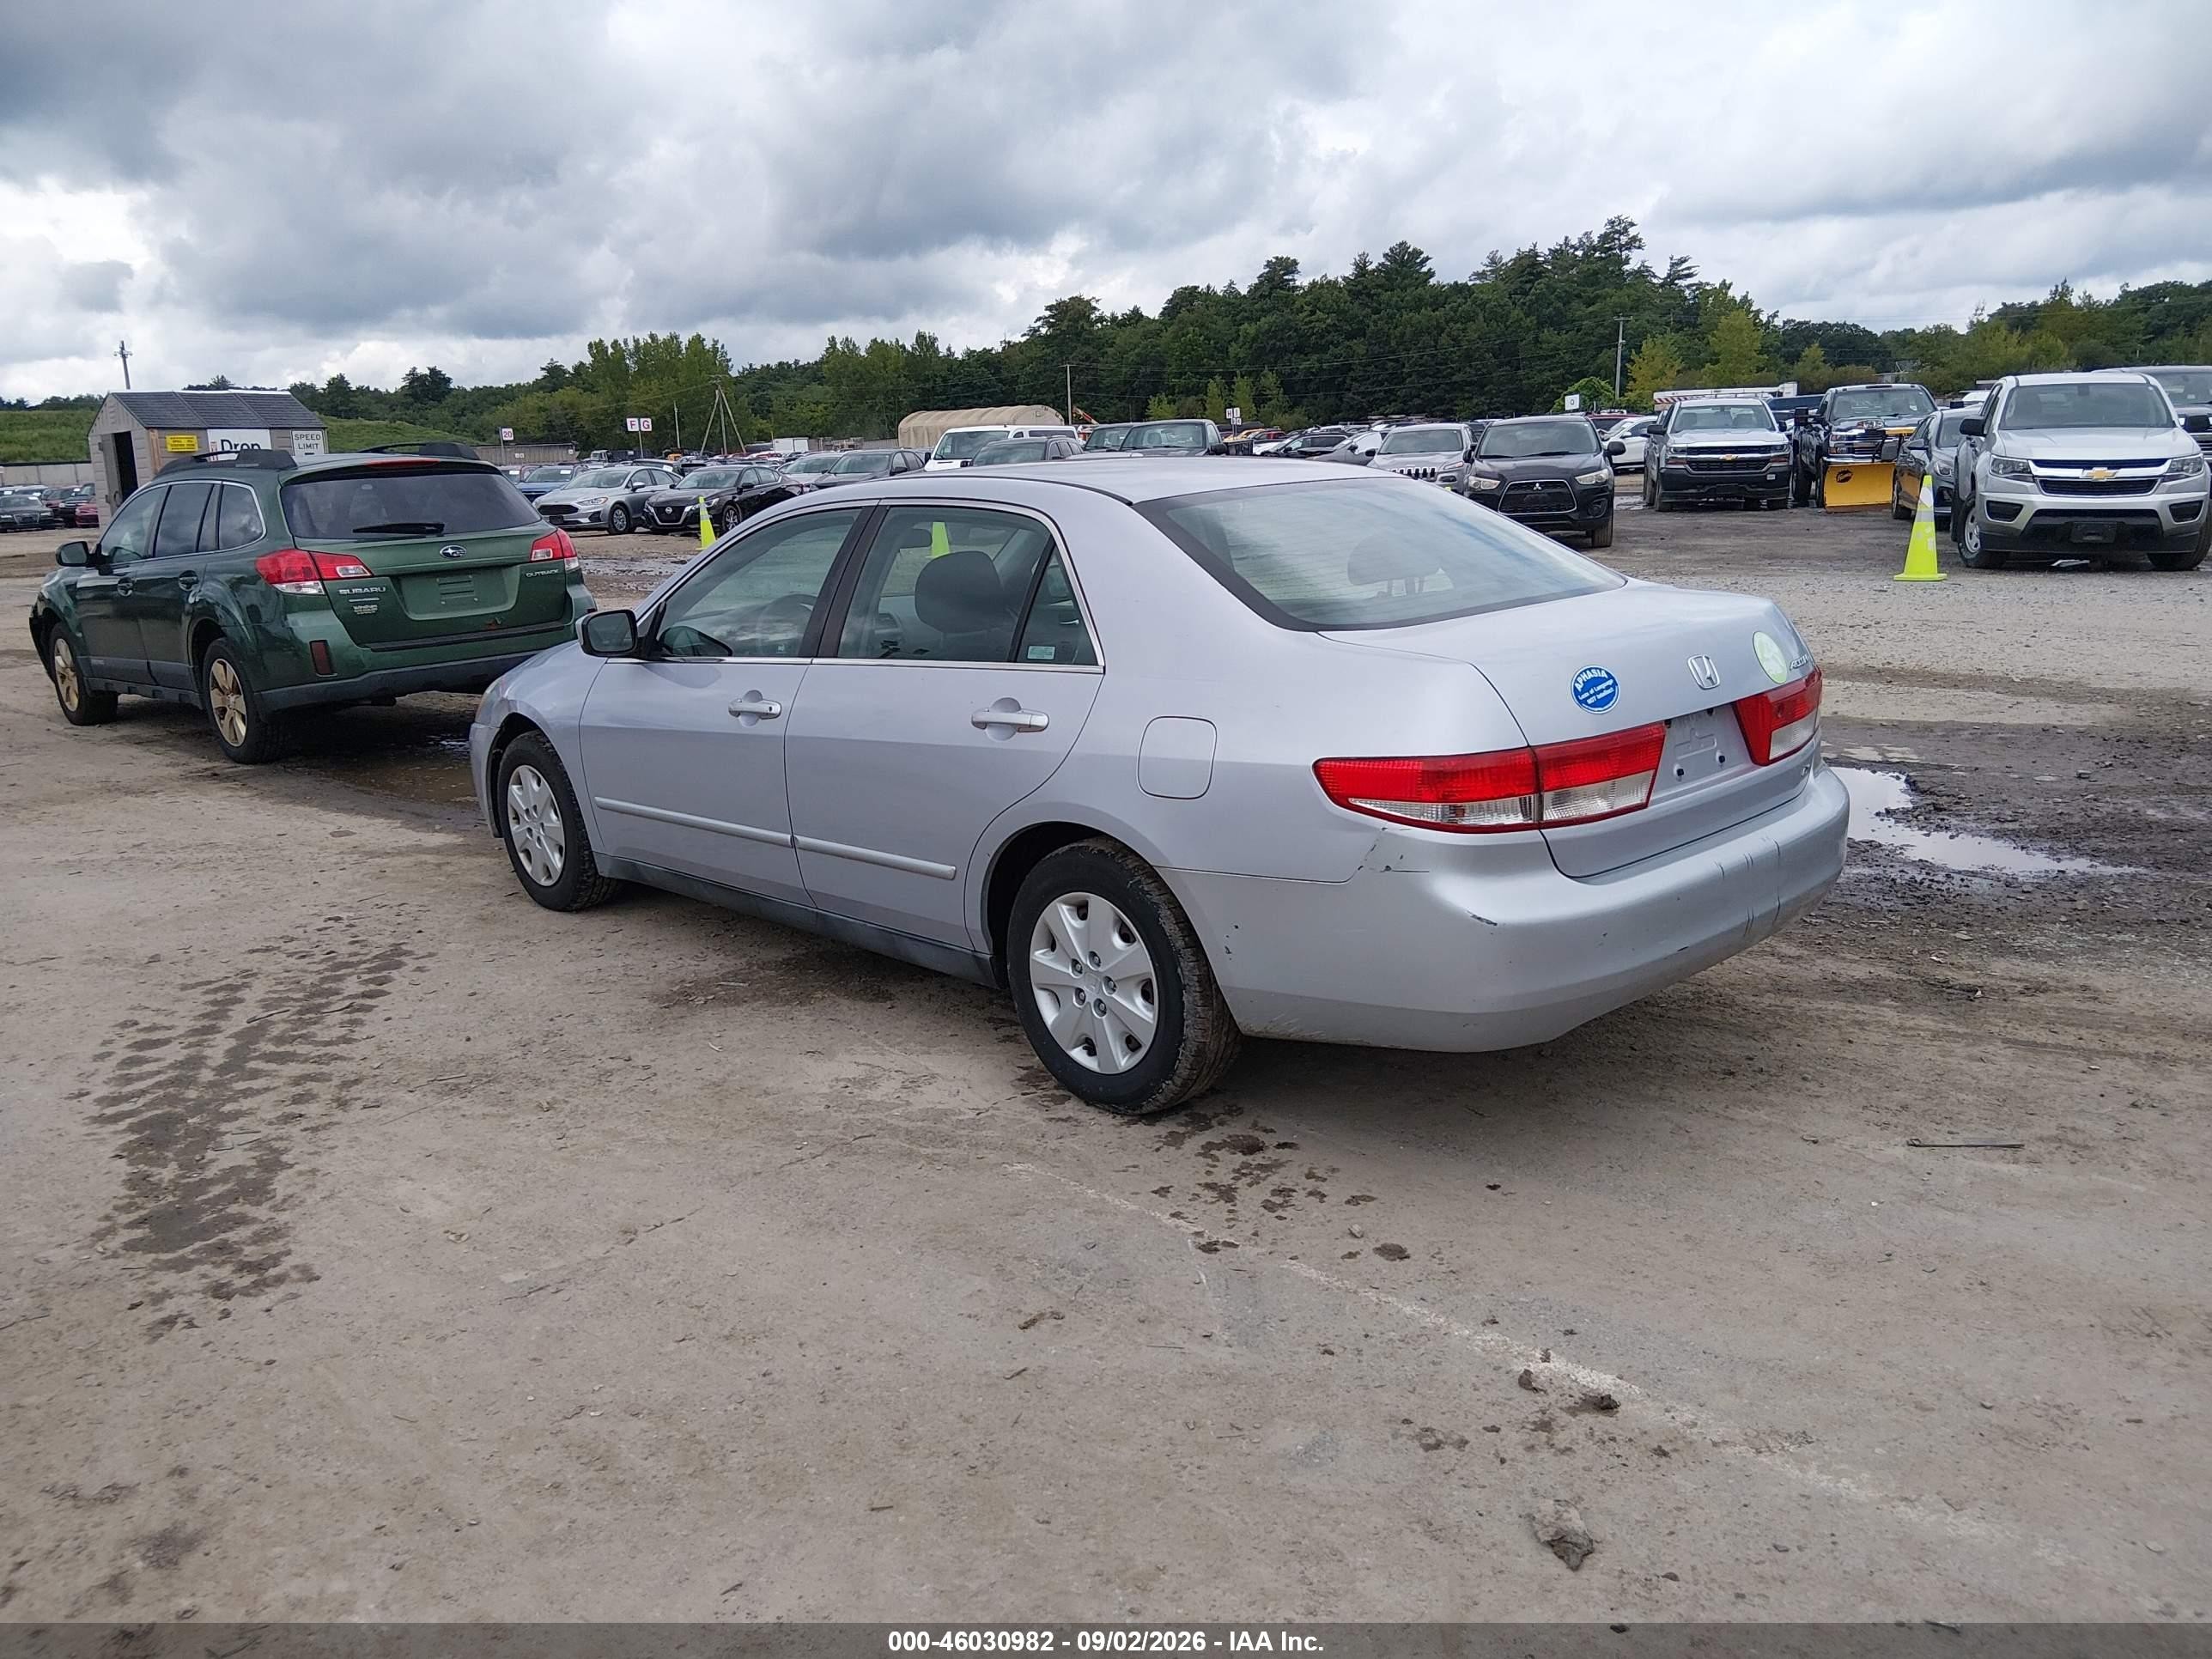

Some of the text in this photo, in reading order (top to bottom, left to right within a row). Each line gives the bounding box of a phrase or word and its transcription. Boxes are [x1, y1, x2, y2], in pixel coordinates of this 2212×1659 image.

[629, 420, 636, 429] F
[642, 420, 650, 429] G
[526, 568, 559, 578] OUTBACK
[338, 586, 386, 595] SUBARU
[1575, 669, 1608, 692] APHASIA
